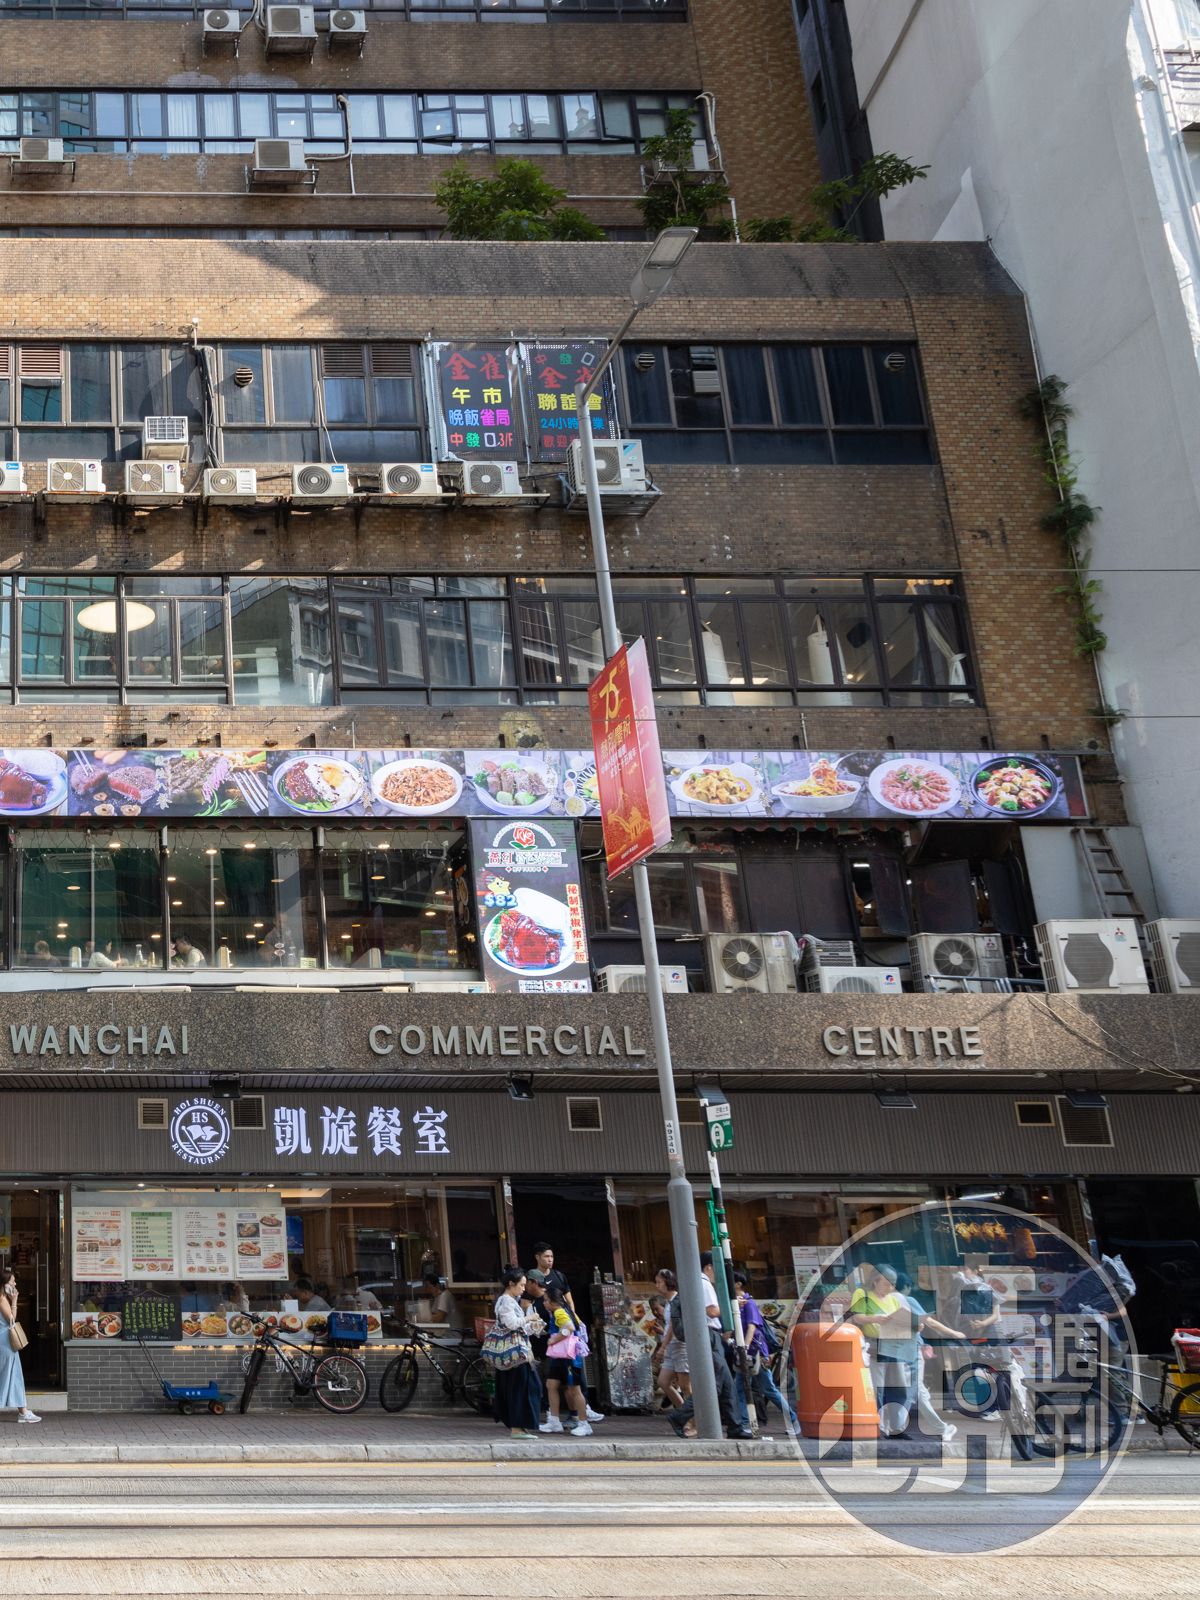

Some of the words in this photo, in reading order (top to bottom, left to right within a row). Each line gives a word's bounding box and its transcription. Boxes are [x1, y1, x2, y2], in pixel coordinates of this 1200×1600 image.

[444, 352, 506, 381] 金雀
[451, 387, 502, 405] 午市
[448, 408, 511, 427] 晚飯雀局
[541, 417, 605, 430] 24小時業
[449, 432, 464, 446] 中
[9, 1024, 189, 1056] WANCHAI
[368, 1025, 647, 1056] COMMERCIAL
[823, 1025, 984, 1057] CENTRE
[173, 1100, 191, 1115] HOI
[193, 1097, 227, 1116] SHUEN
[191, 1111, 209, 1123] HS
[273, 1105, 450, 1156] 凱旋餐室
[171, 1142, 230, 1165] RESTAURANT
